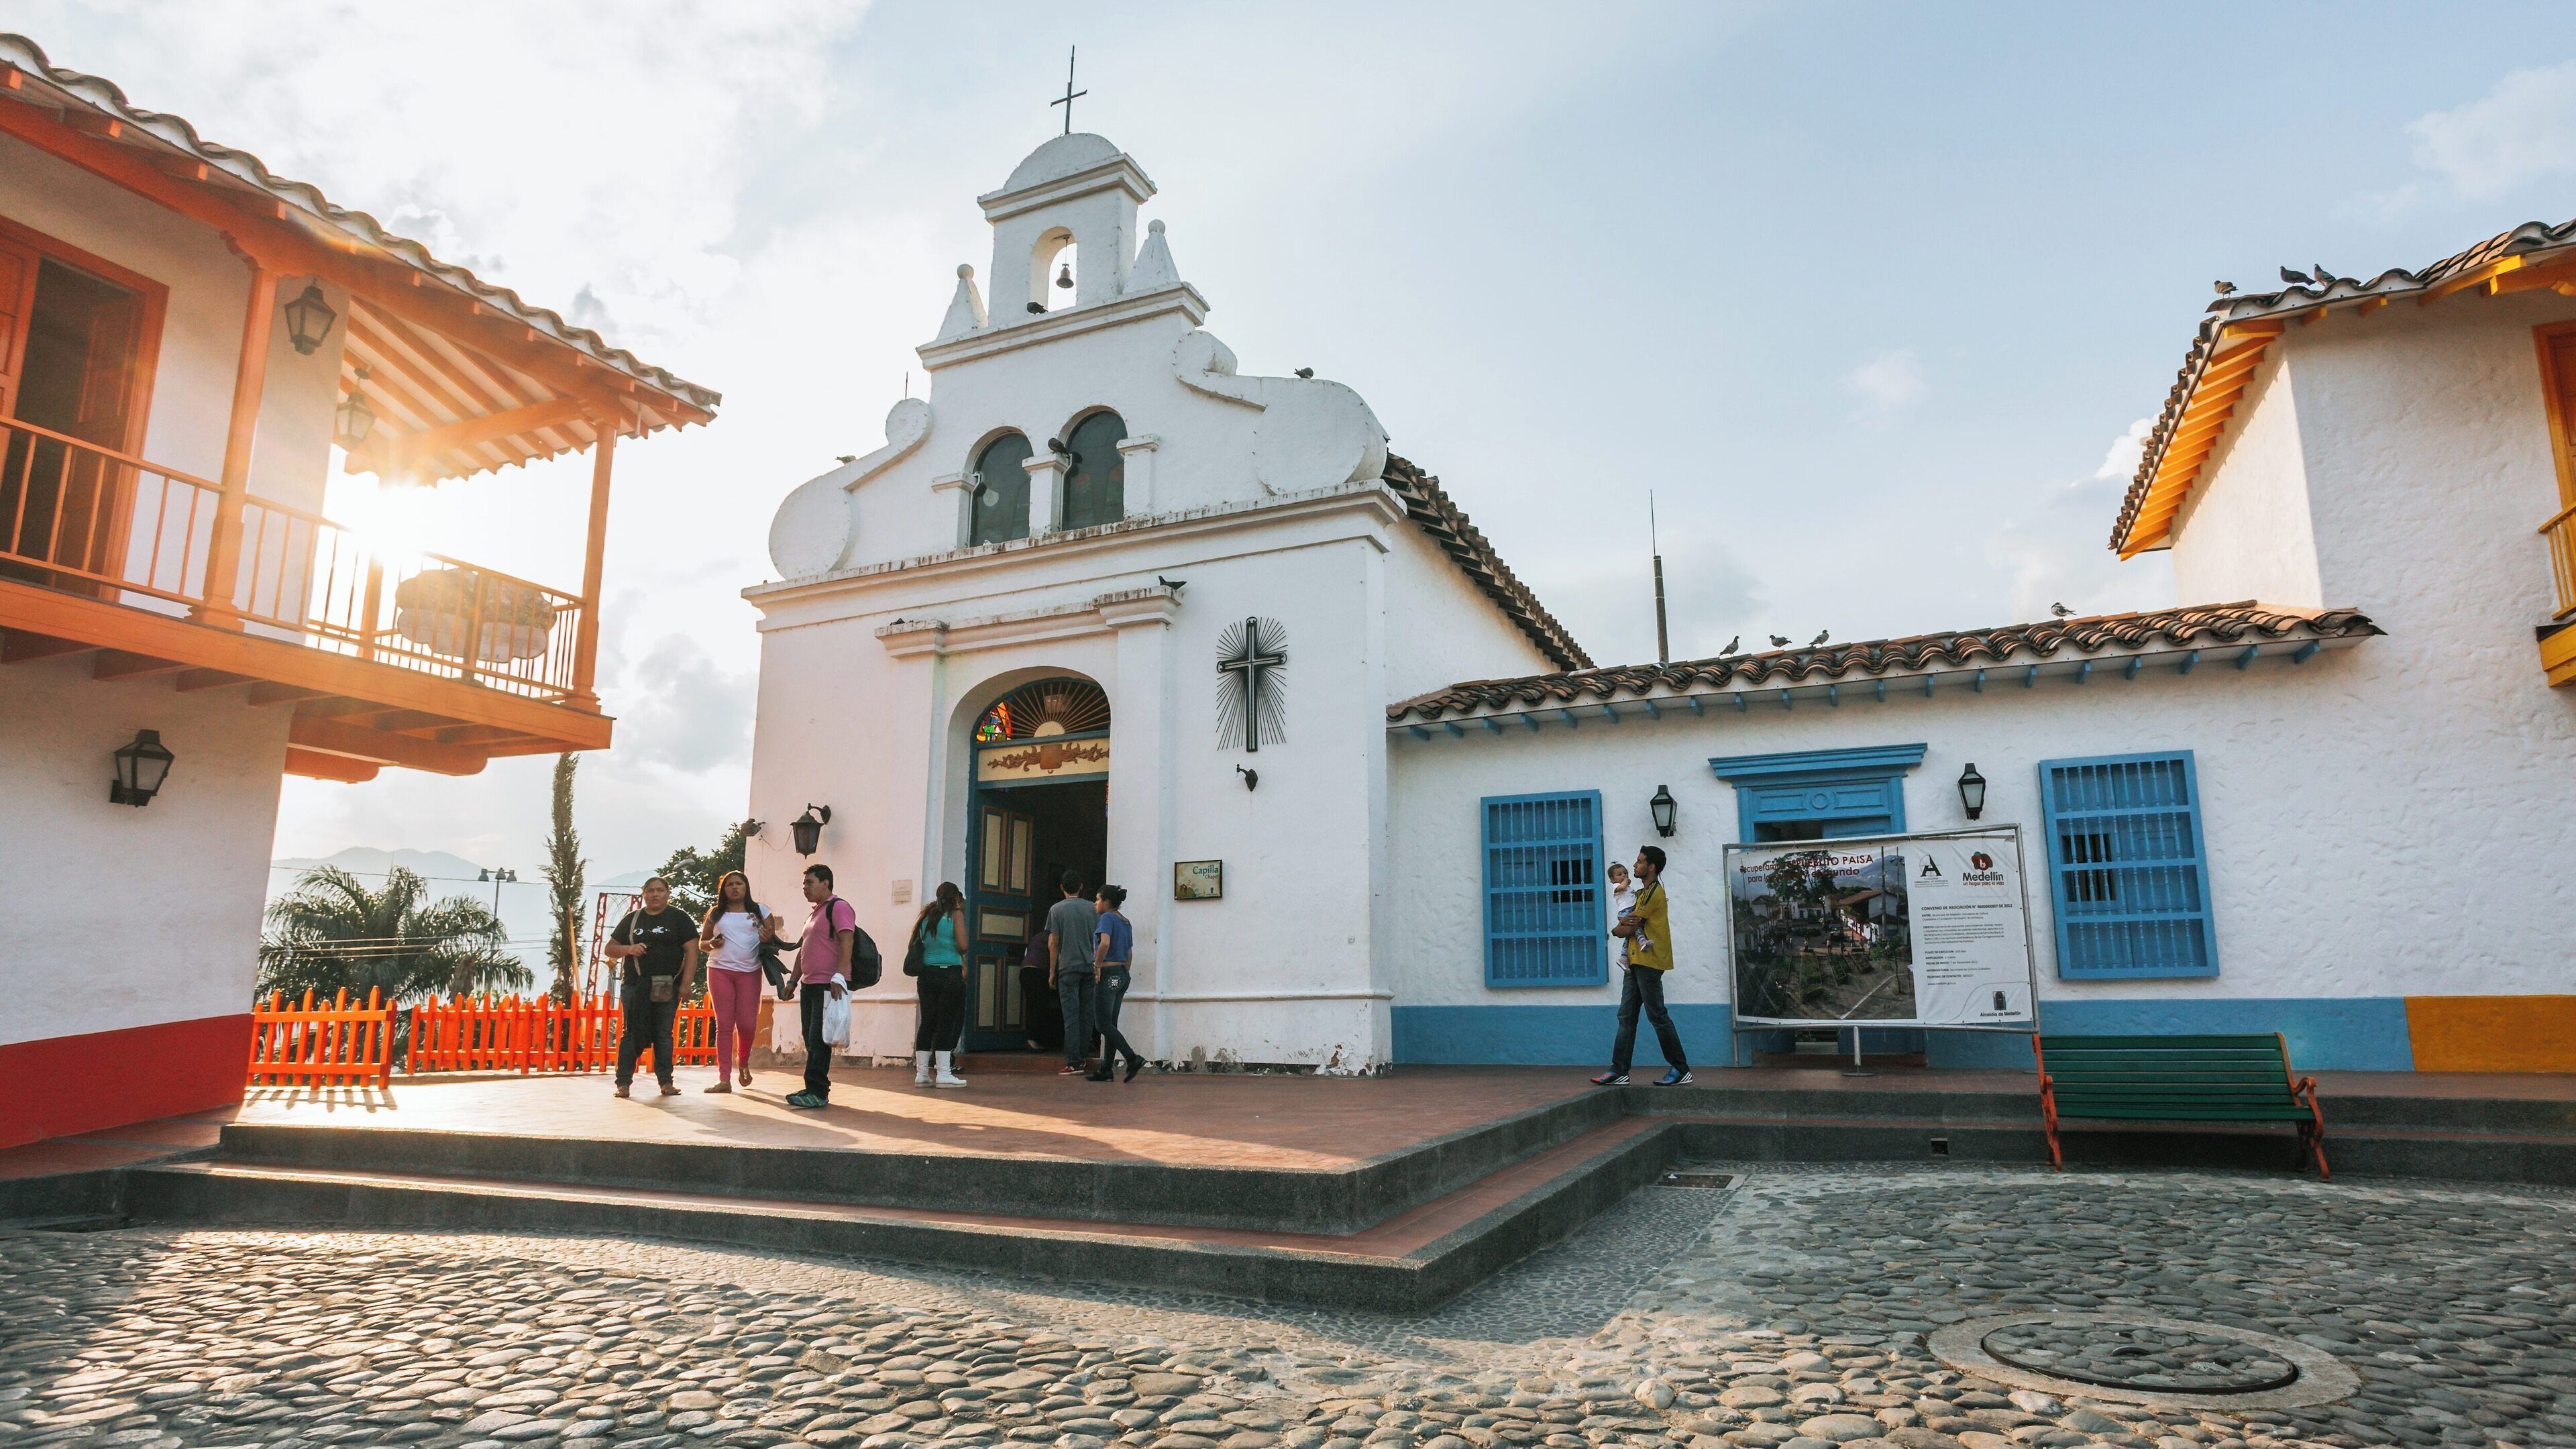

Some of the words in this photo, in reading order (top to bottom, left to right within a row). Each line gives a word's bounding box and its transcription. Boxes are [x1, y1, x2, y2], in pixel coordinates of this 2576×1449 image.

[1842, 855, 1874, 865] PAISA
[1192, 864, 1218, 876] Capilla
[1748, 876, 1763, 884] para
[1963, 872, 2004, 881] Medellín
